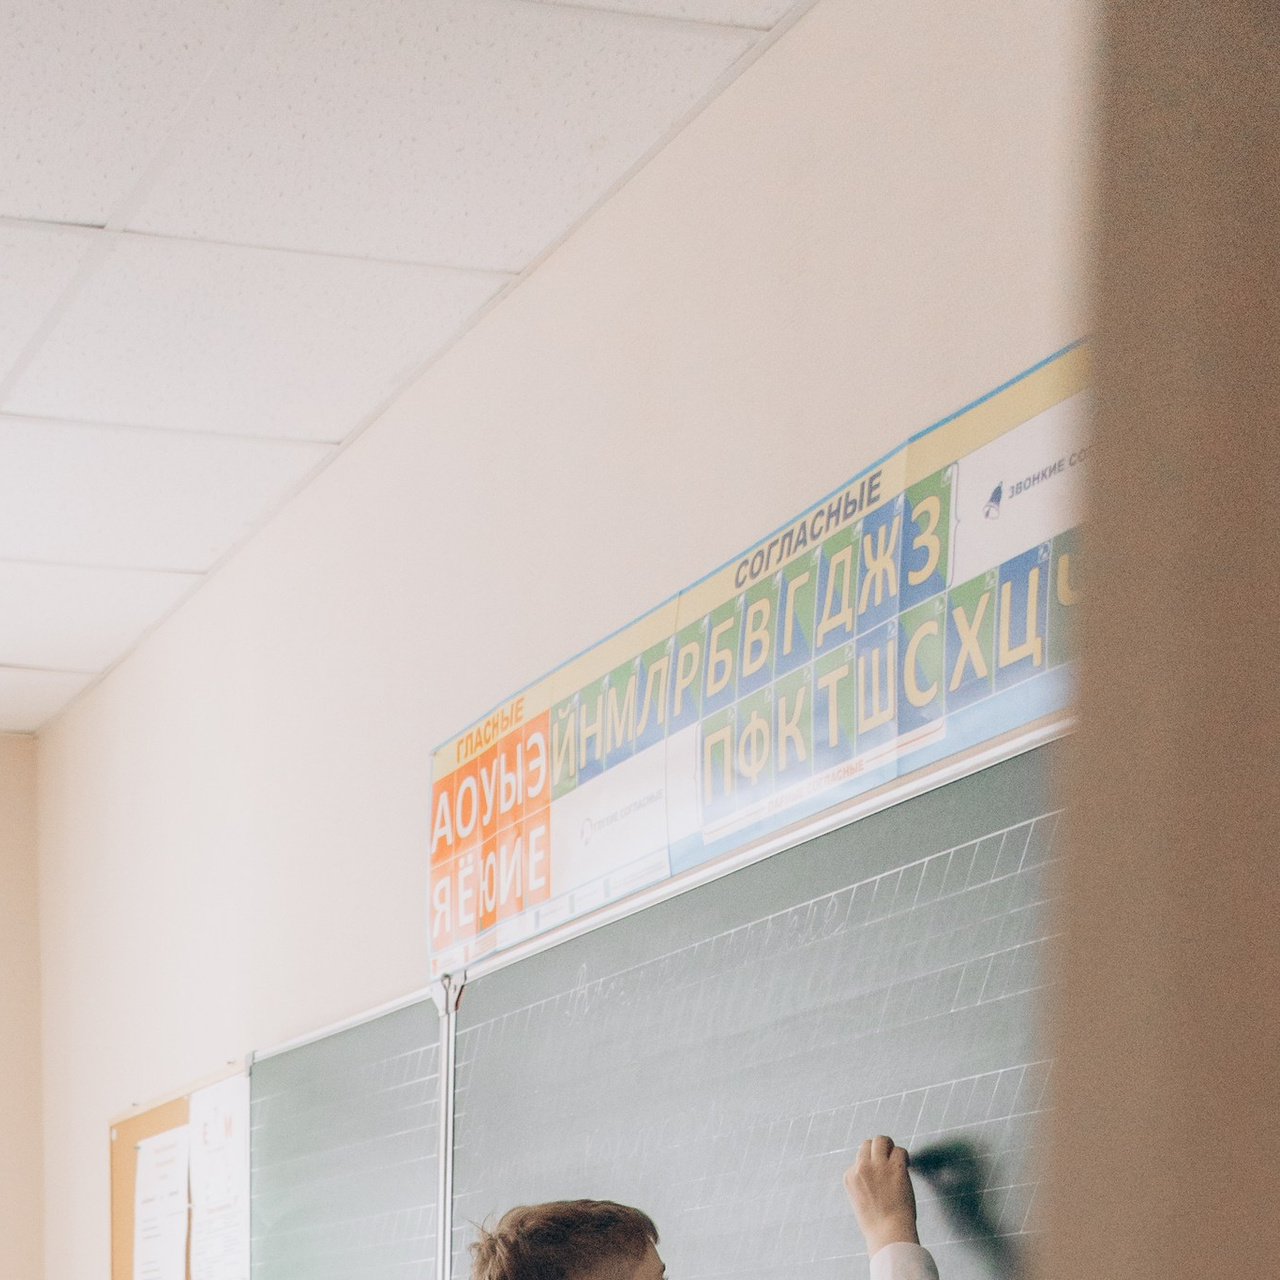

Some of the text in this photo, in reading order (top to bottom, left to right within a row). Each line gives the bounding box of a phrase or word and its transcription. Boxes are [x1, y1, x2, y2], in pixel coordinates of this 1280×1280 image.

[1008, 457, 1066, 500] ЗВОНКИЕ
[734, 469, 882, 589] СОГЛАСНЫЕ
[456, 696, 525, 763] ГЛАСНЫЕ
[806, 759, 865, 793] СОГЛАСНЫЕ
